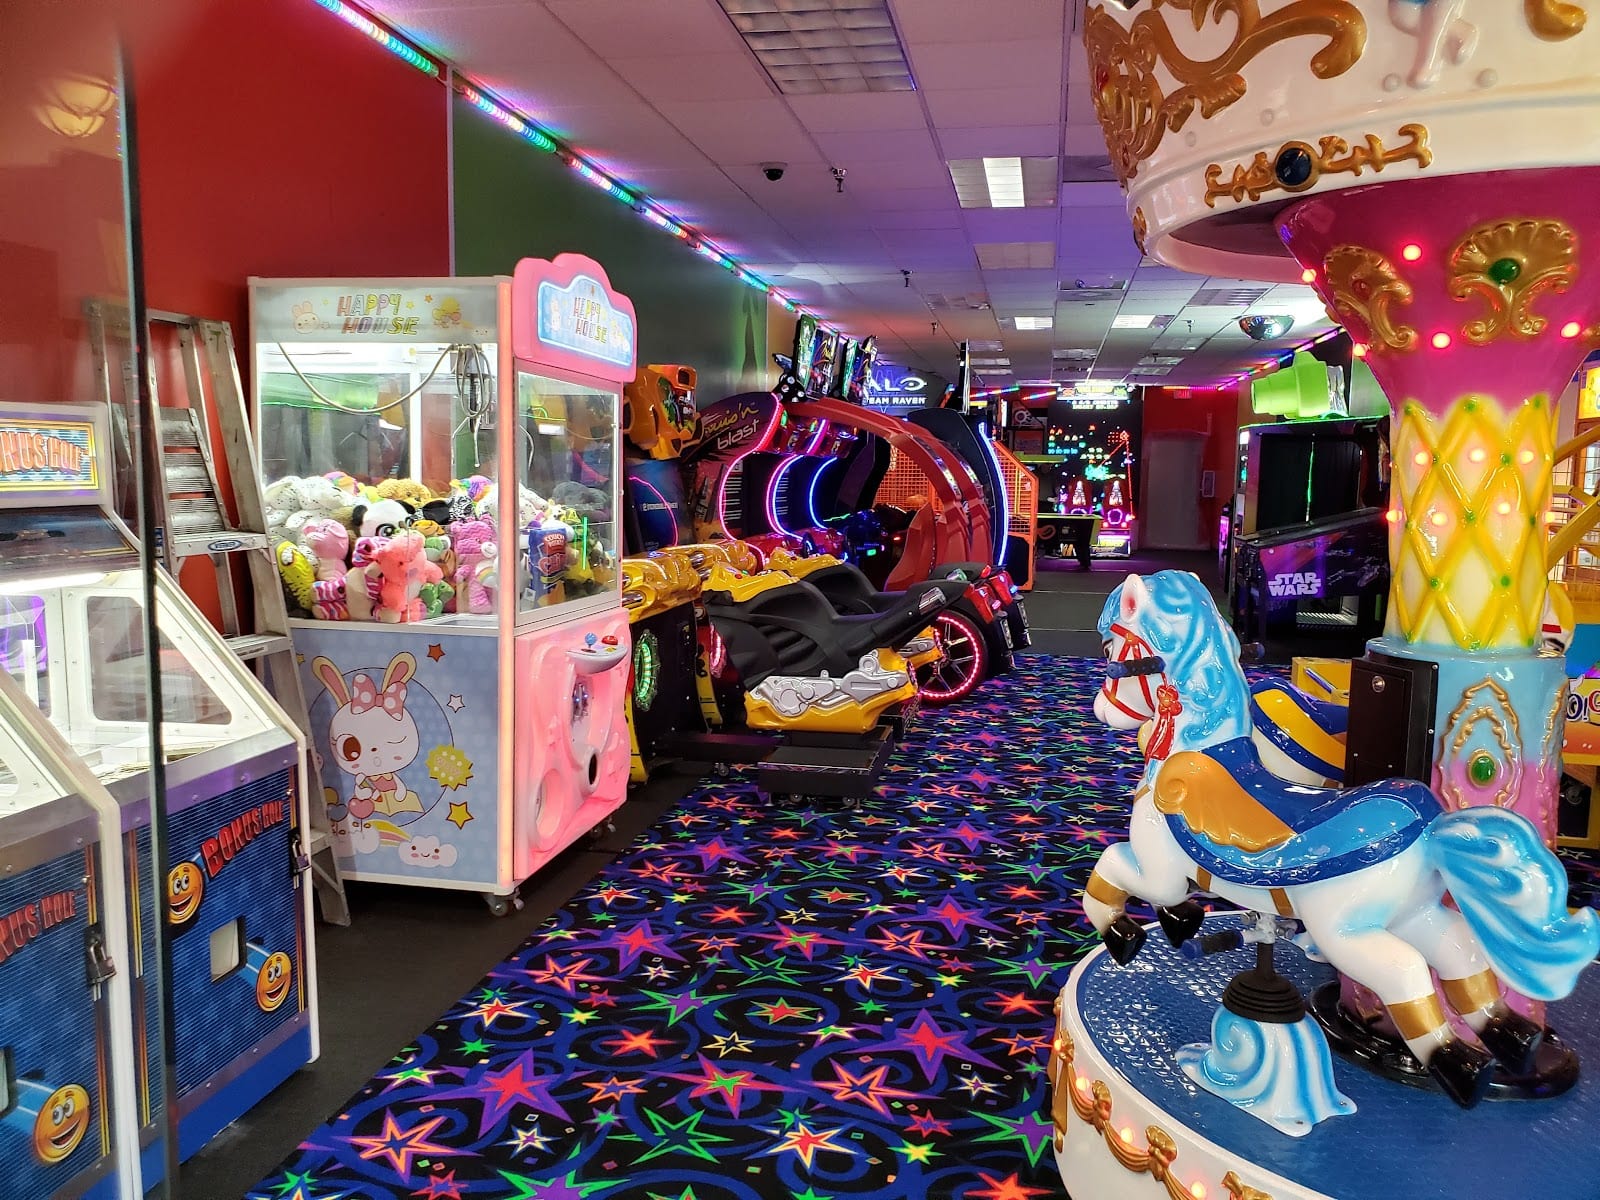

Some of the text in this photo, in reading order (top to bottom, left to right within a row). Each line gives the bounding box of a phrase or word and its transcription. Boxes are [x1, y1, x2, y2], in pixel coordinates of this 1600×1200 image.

[337, 293, 402, 316] HAPPY
[573, 297, 601, 323] HAPPY
[341, 316, 420, 335] HOUSE
[575, 319, 607, 343] HOUSE
[866, 373, 928, 392] ALO
[868, 397, 926, 405] EAM RAVEN
[717, 418, 760, 450] blast
[0, 431, 81, 475] NUS HOLE
[1267, 572, 1321, 586] STAR
[1268, 583, 1321, 597] WARS
[201, 807, 261, 878] BONUS
[40, 891, 77, 929] HOLE
